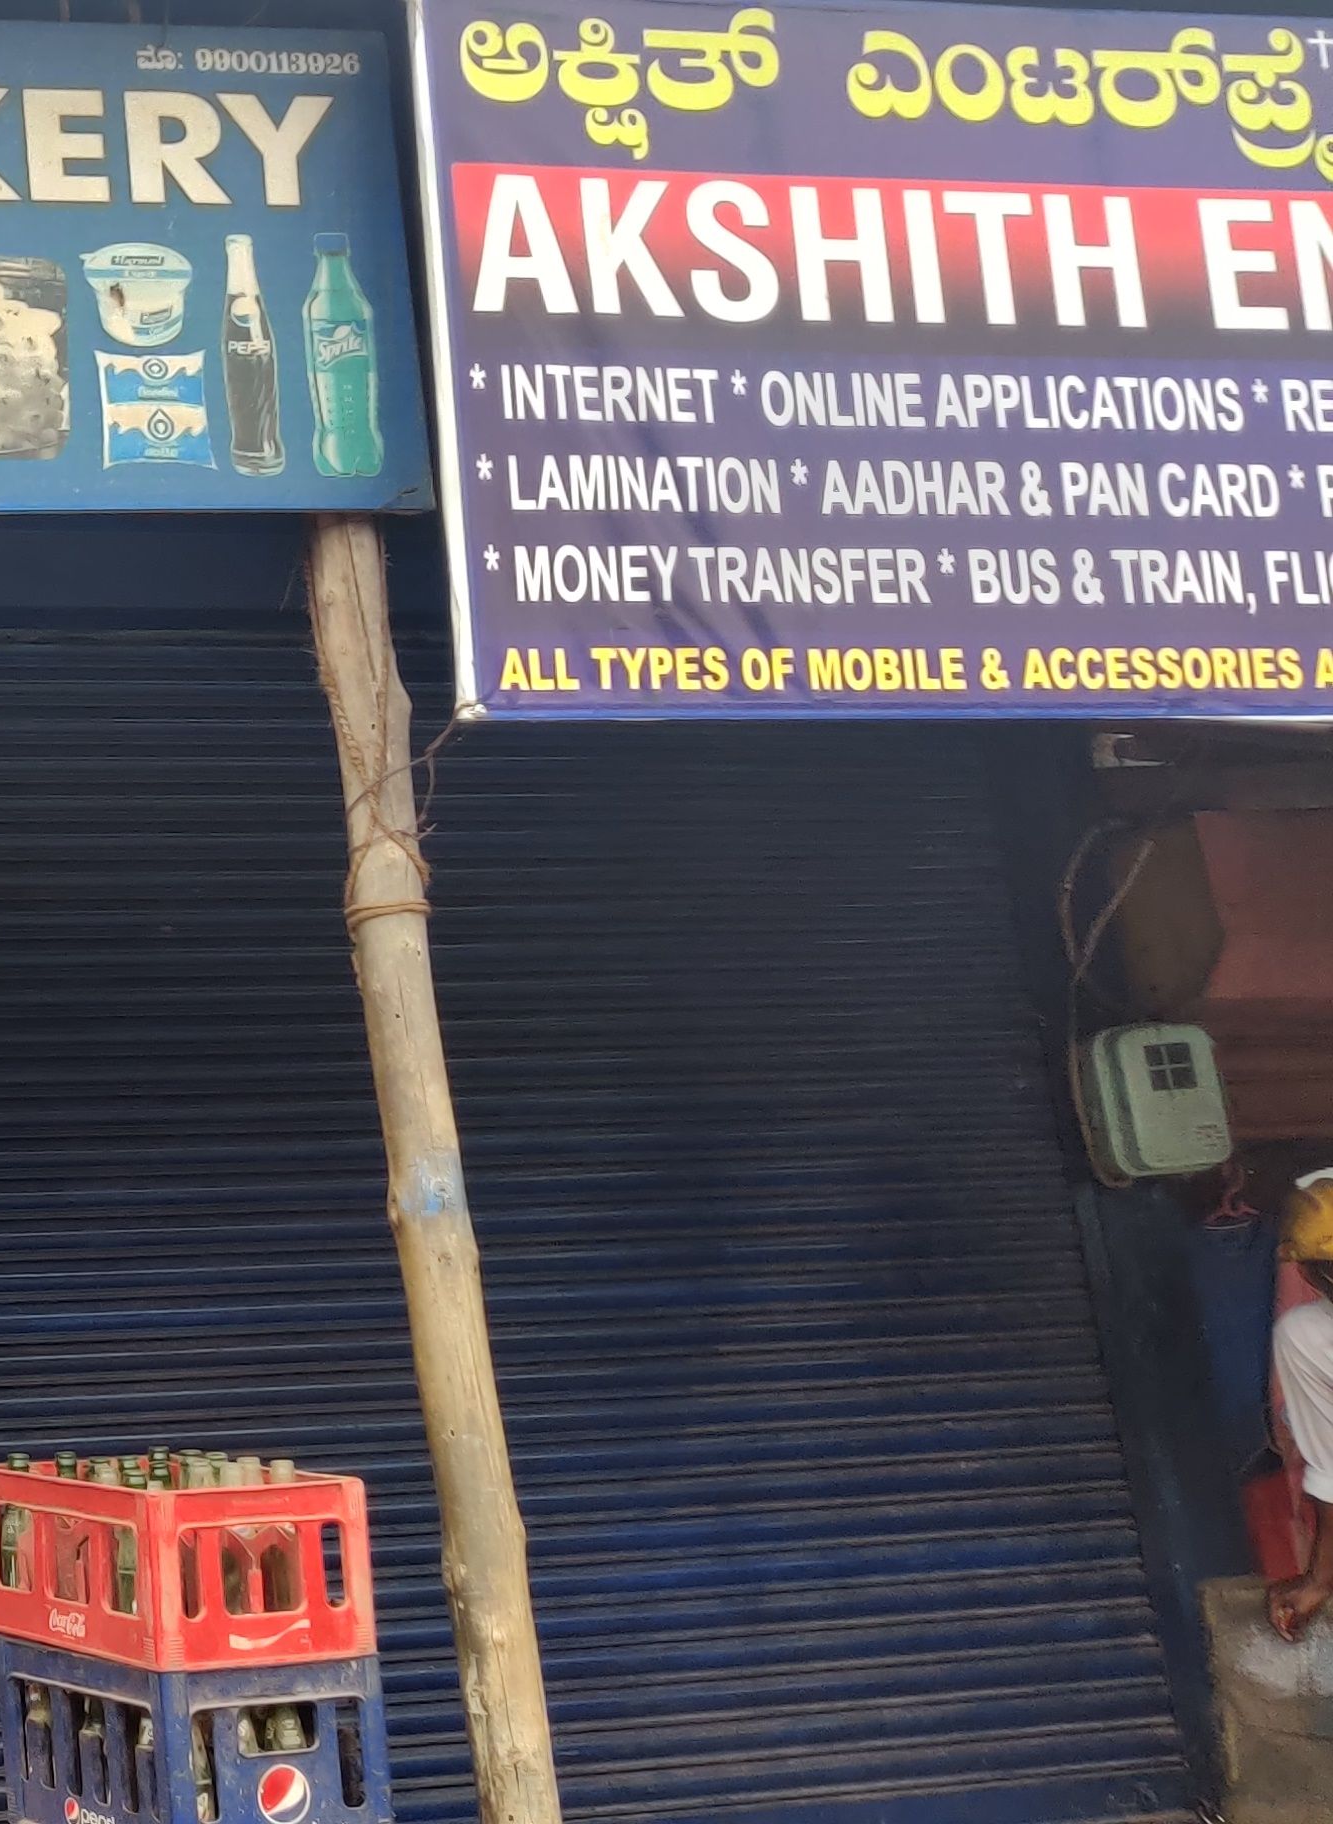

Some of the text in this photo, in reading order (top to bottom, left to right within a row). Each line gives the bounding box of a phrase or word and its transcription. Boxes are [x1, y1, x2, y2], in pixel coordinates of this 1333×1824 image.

[195, 47, 361, 75] 9900113926
[459, 7, 780, 160] ಅಕ್ಷಿತ್
[472, 172, 1148, 329] AKSHITH
[500, 364, 719, 425] INTERNET
[760, 369, 925, 429] ONLINE
[935, 373, 1244, 433] APPLICATIONS
[508, 454, 782, 515] LAMINATION
[821, 459, 1011, 517] AADHAR
[1019, 461, 1053, 517] &
[1062, 461, 1150, 518] PAN
[1158, 463, 1280, 518] CARD
[514, 544, 1333, 614] MONEY TRANSFER BUS & TRAIN, FLI
[500, 647, 580, 692] ALL
[591, 647, 729, 692] TYPES
[741, 647, 795, 692] OF
[809, 648, 967, 691] MOBILE
[979, 648, 1009, 691] &
[1022, 647, 1303, 691] ACCESSORIES
